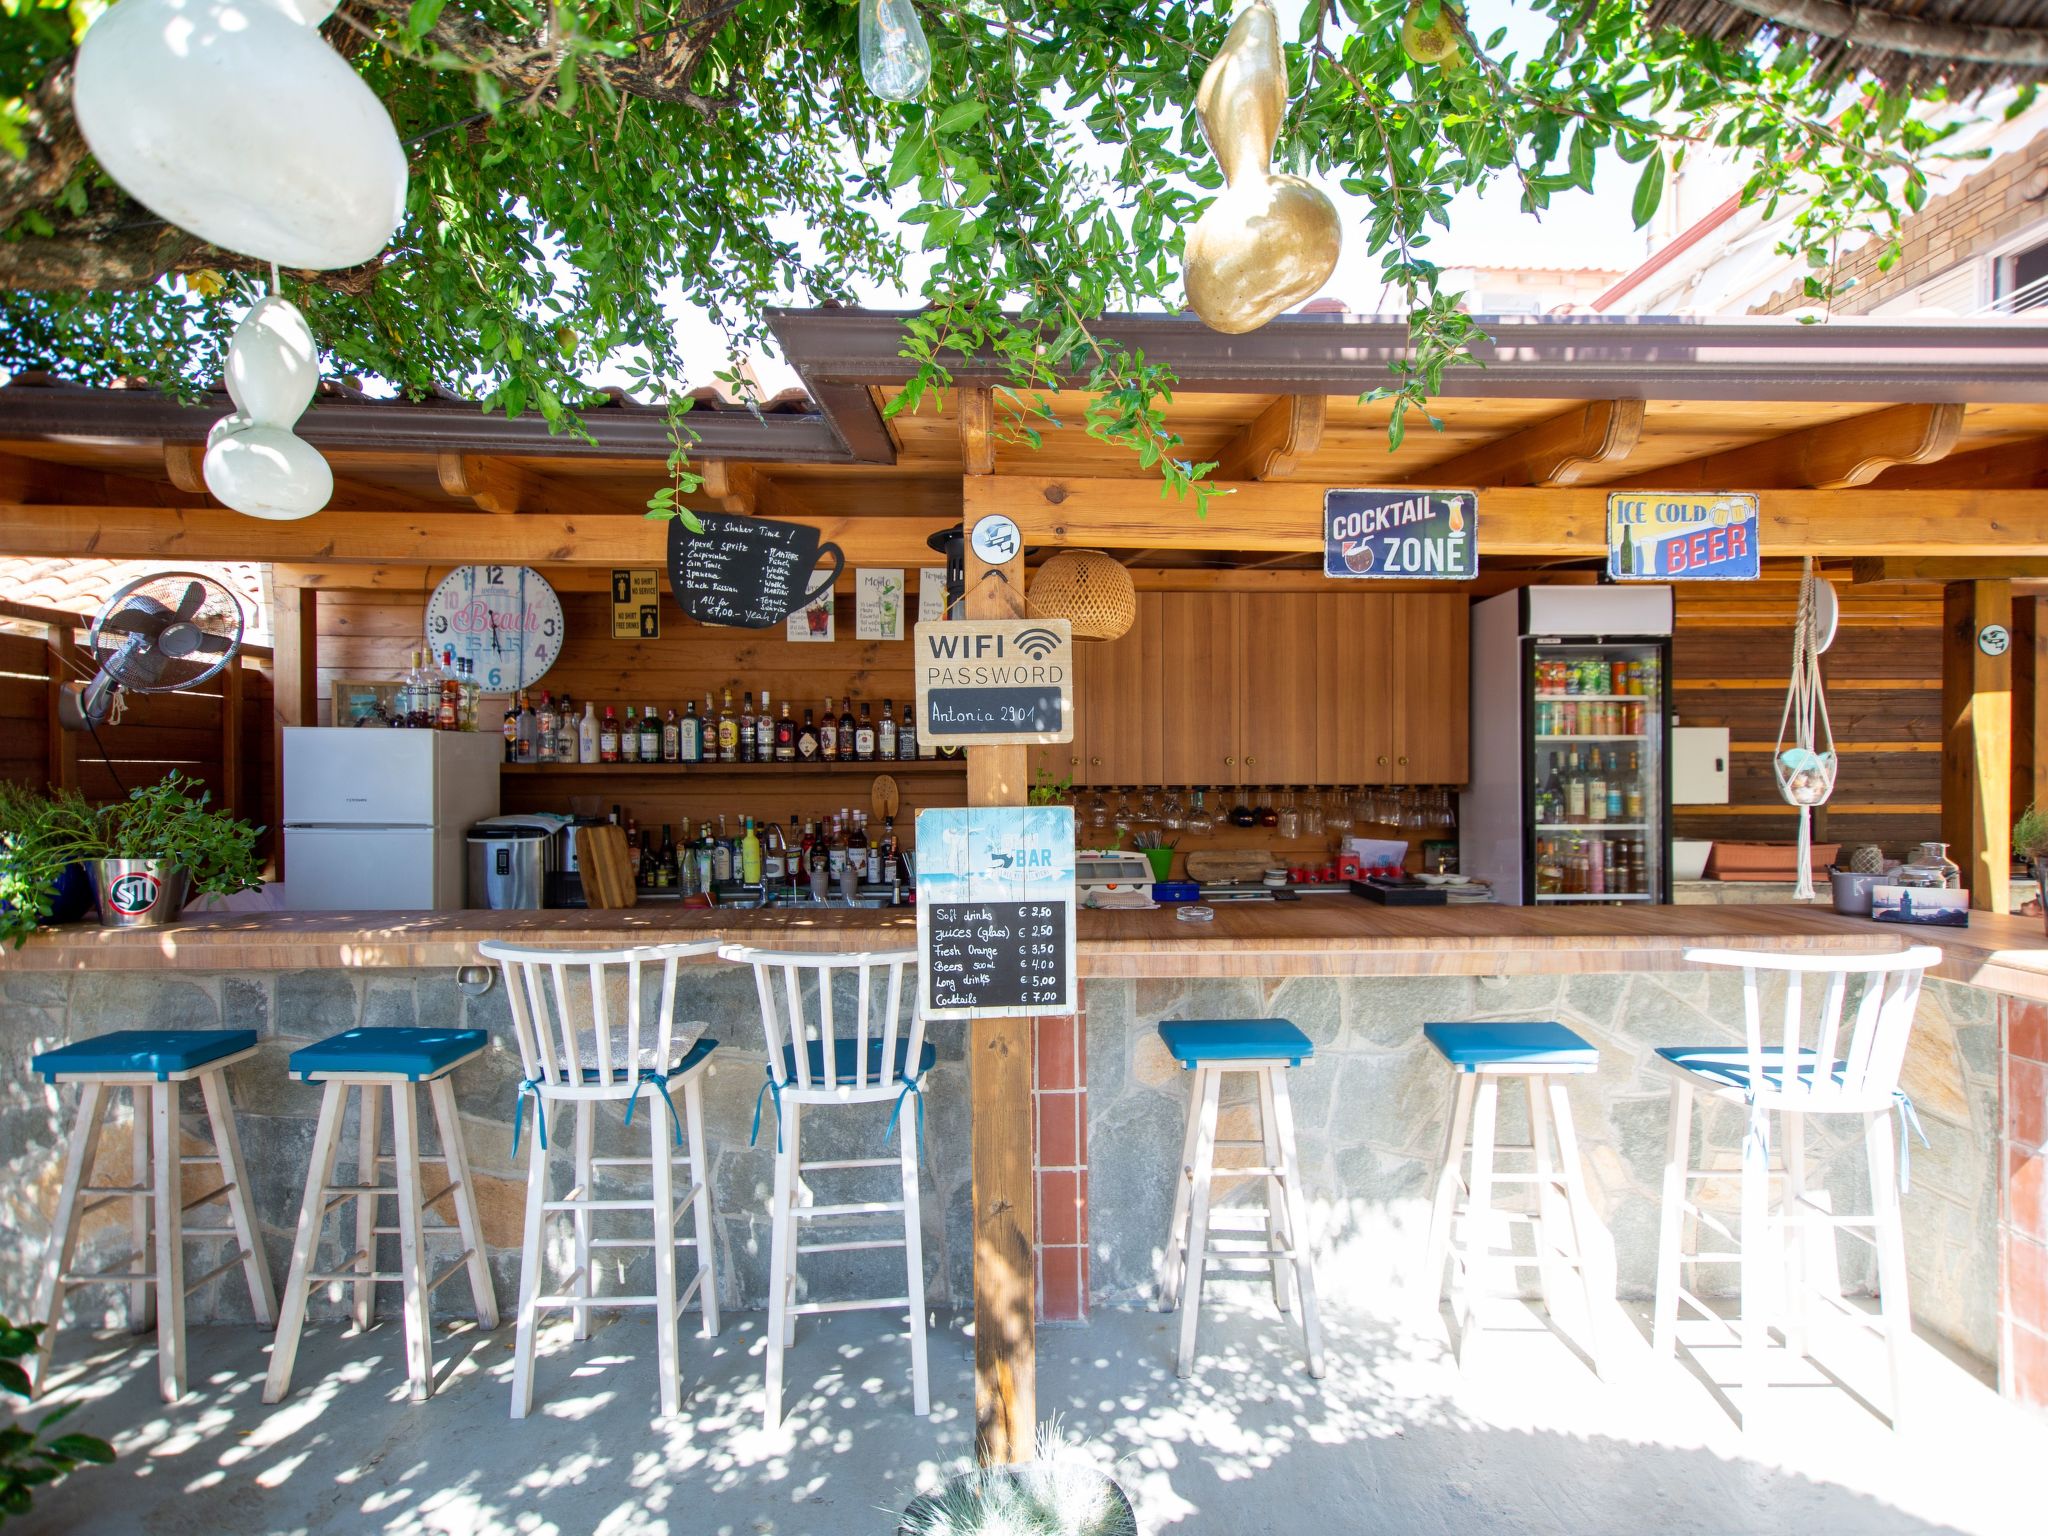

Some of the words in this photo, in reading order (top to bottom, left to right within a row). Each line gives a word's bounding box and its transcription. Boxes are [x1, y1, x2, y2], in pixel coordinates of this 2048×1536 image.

[1333, 496, 1436, 540] COCKTAIL
[1617, 501, 1647, 524] ICE
[1655, 503, 1707, 522] COLD
[723, 522, 754, 533] Shaker
[759, 526, 781, 538] Time
[1384, 537, 1464, 572] ZONE
[1667, 525, 1748, 575] BEER
[486, 566, 504, 584] 12
[443, 591, 459, 609] 10
[700, 595, 715, 605] All
[435, 615, 448, 634] 9
[452, 600, 539, 633] Beach
[544, 619, 555, 636] 3
[535, 644, 548, 662] 4
[928, 635, 1003, 659] WIFI
[488, 668, 501, 686] 6
[928, 666, 1063, 685] PASSWORD
[932, 701, 995, 722] Antonia
[1000, 706, 1035, 723] 2901
[1016, 849, 1052, 867] BAR
[936, 908, 957, 922] Soft
[964, 910, 993, 921] drinks
[1018, 906, 1027, 917] €
[977, 925, 1010, 942] (glass)
[1018, 928, 1026, 938] €
[933, 944, 961, 957] Fresh
[968, 945, 998, 959] Orange
[1019, 945, 1026, 954] €
[1031, 944, 1055, 955] 3,50
[933, 961, 964, 972] Beers
[1020, 960, 1027, 968] €
[936, 977, 956, 992] Long
[1020, 976, 1028, 984] €
[1021, 992, 1028, 1002] €
[1033, 992, 1057, 1003] 7,00
